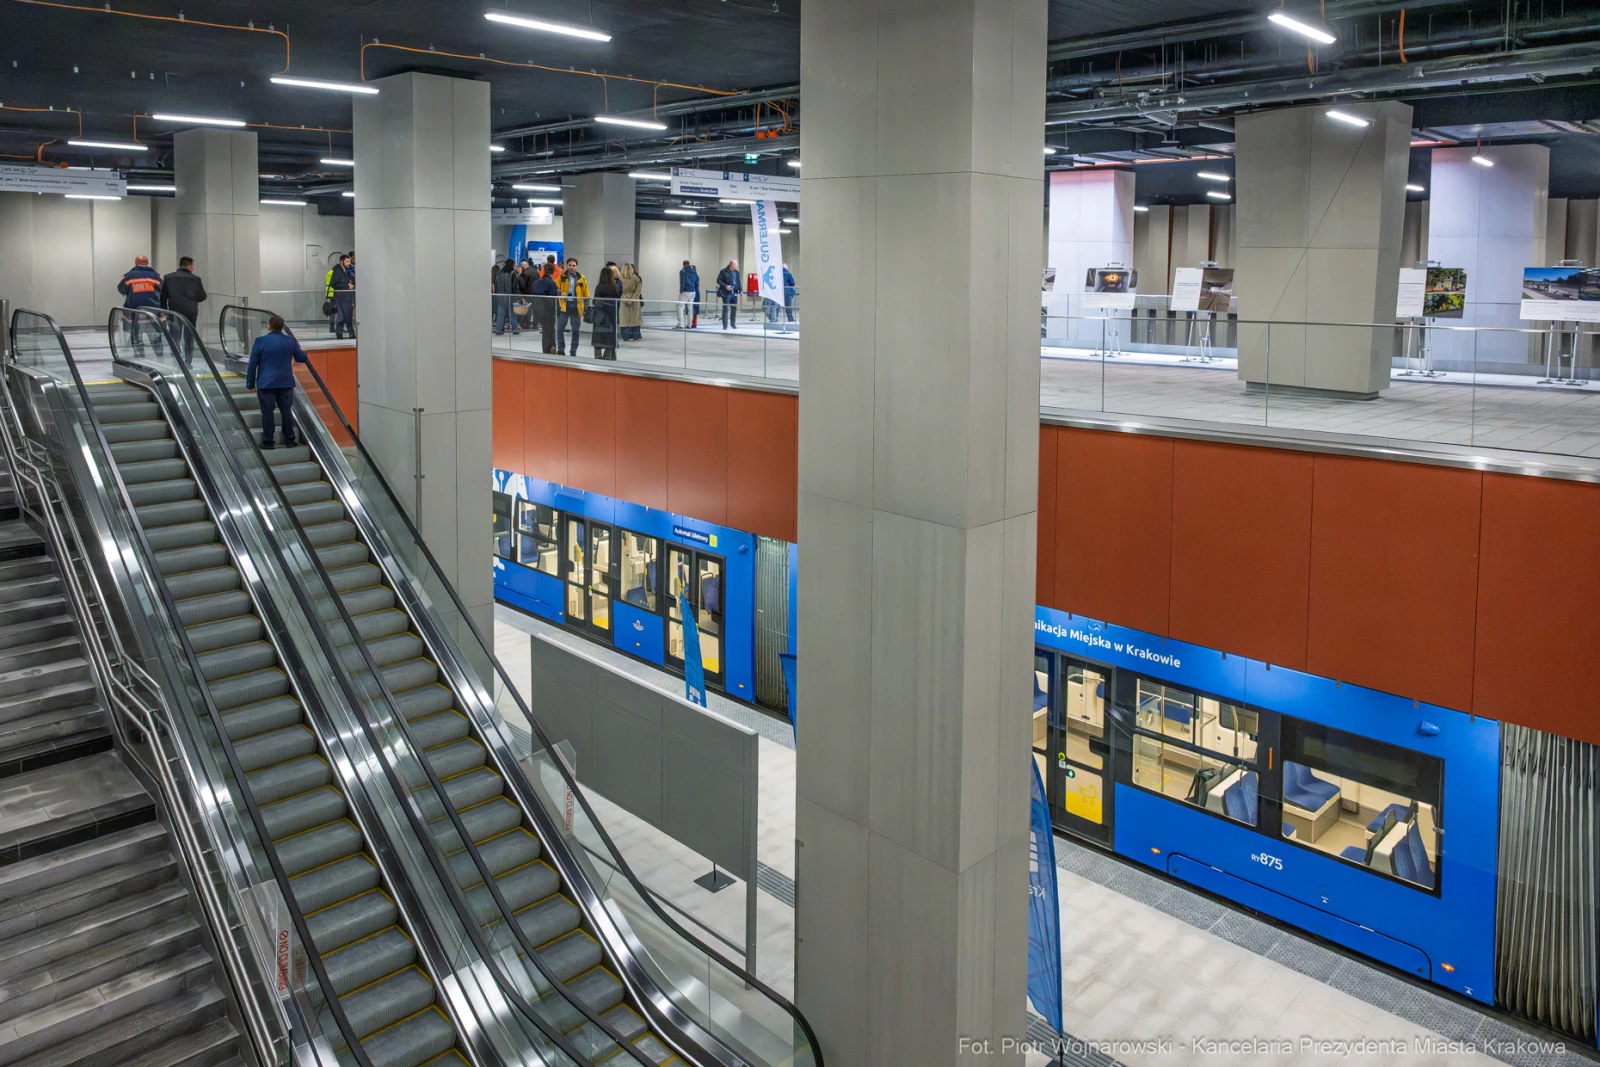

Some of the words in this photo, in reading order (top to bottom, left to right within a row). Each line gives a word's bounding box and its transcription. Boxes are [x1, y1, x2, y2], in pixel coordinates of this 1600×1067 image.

[674, 527, 691, 537] Automat
[691, 532, 709, 543] biletowy
[1070, 628, 1111, 648] Miejska
[1113, 642, 1124, 652] w
[1126, 644, 1181, 668] Krakowie
[279, 941, 288, 953] NO
[278, 953, 288, 991] CLIMBING
